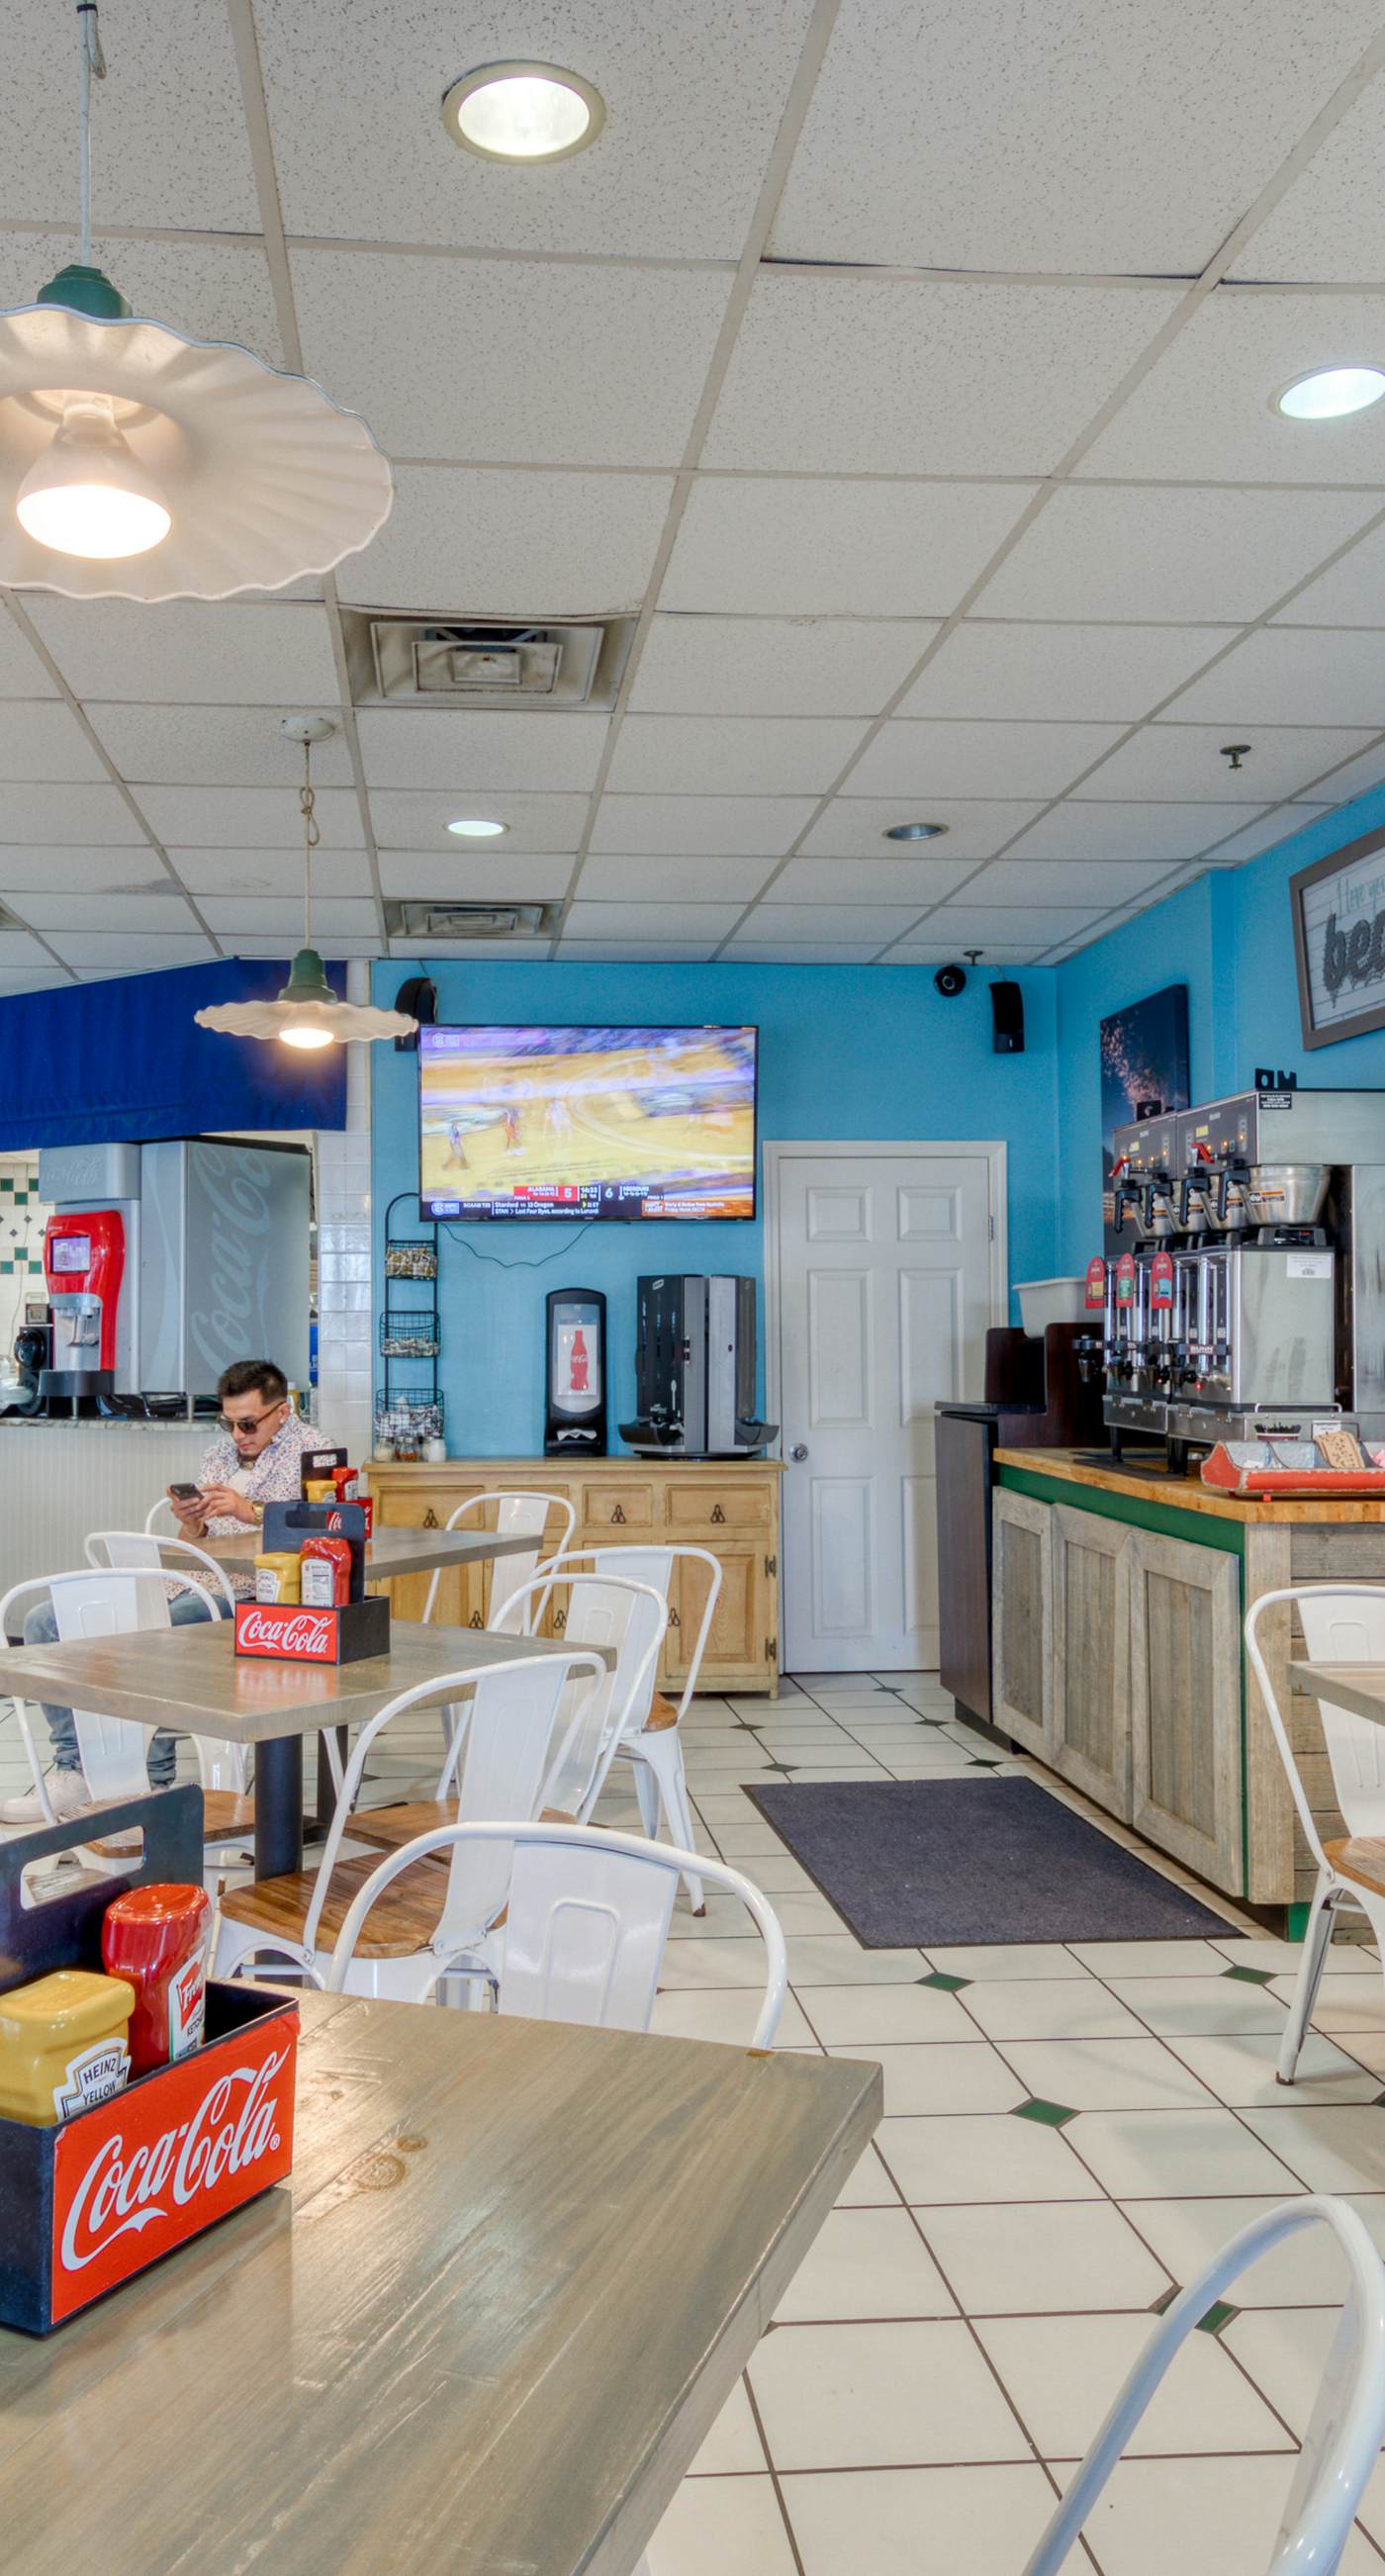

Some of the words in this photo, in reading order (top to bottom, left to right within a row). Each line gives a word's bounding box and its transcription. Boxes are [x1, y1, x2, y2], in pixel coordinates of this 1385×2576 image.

[563, 1187, 573, 1198] 5
[604, 1187, 613, 1198] 6
[238, 1610, 333, 1654] Coca-Cola
[83, 2058, 117, 2084] HEINZ
[83, 2079, 118, 2106] YELLOW
[61, 2043, 291, 2271] Coca-Cola
